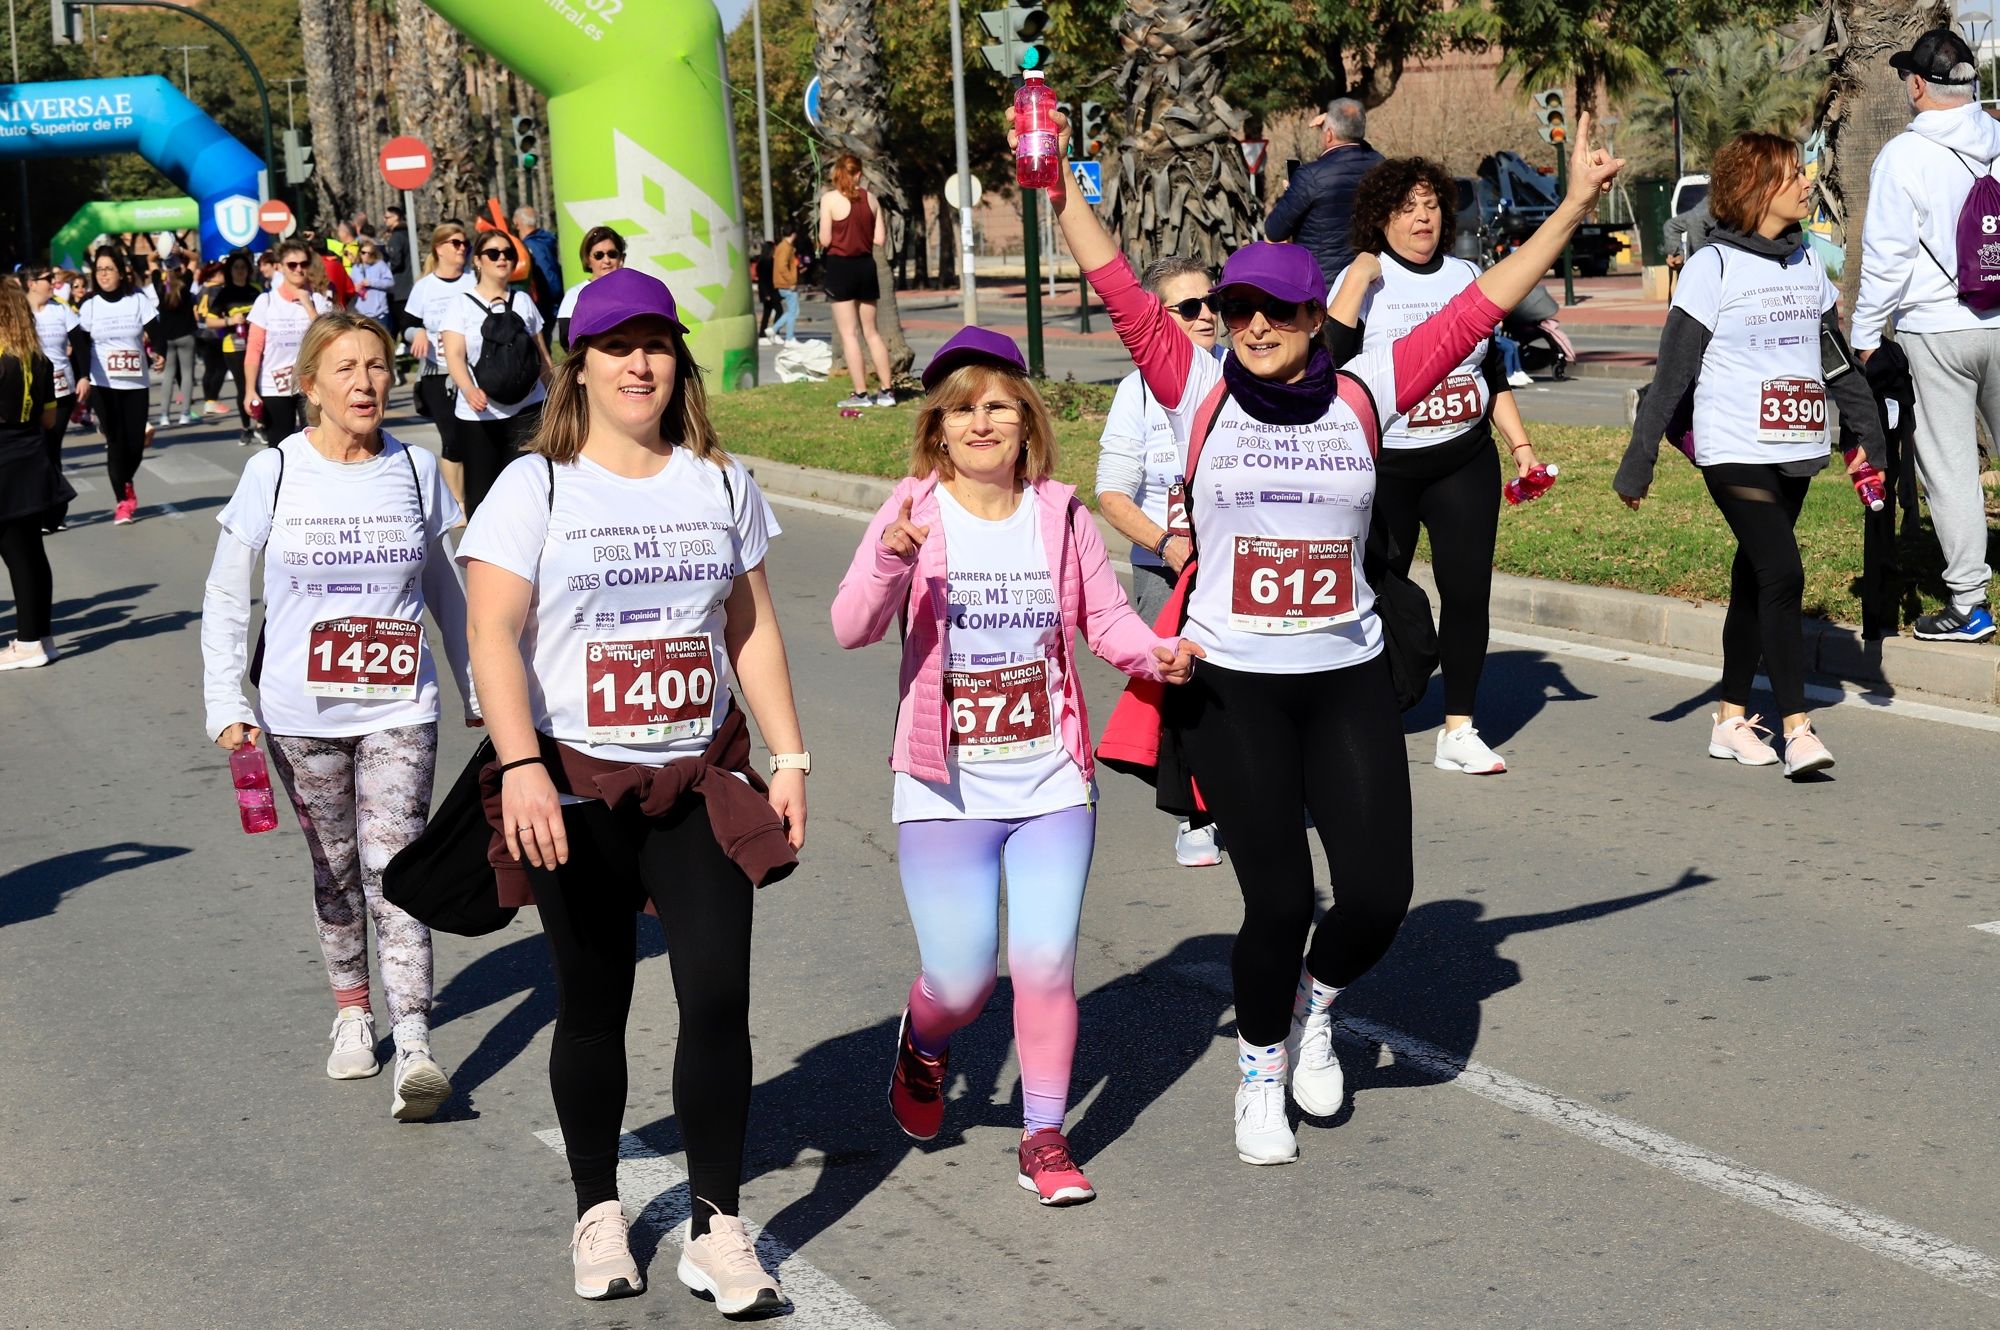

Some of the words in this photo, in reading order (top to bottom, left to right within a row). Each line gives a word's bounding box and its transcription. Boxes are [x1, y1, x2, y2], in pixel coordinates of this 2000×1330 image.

[31, 120, 90, 136] Superior
[92, 118, 111, 131] de
[114, 117, 133, 129] FP
[1782, 292, 1796, 305] MÍ
[108, 357, 140, 369] 1516
[1777, 384, 1800, 396] mujer
[1411, 390, 1477, 422] 2851
[1763, 398, 1824, 423] 3390
[1152, 423, 1167, 431] VIII
[1221, 420, 1238, 428] VIII
[1284, 425, 1296, 433] DE
[1299, 425, 1312, 434] LA
[1237, 436, 1271, 450] POR
[1274, 434, 1300, 452] MÍ
[1302, 440, 1314, 452] Y
[1318, 437, 1352, 452] POR
[1211, 455, 1239, 470] MIS
[1243, 453, 1373, 472] COMPAÑERAS
[286, 518, 302, 526] VIII
[349, 517, 360, 525] DE
[363, 516, 374, 524] LA
[376, 515, 402, 524] MUJER
[305, 533, 336, 545] POR
[340, 526, 361, 544] MÍ
[364, 531, 376, 543] Y
[378, 530, 407, 543] POR
[565, 529, 587, 540] VIII
[590, 527, 640, 538] CARRERA
[643, 525, 656, 534] DE
[660, 524, 672, 533] LA
[676, 522, 709, 532] MUJER
[284, 551, 308, 566] MIS
[312, 545, 423, 566] COMPAÑERAS
[594, 545, 631, 562] POR
[634, 536, 660, 558] MÍ
[664, 542, 676, 557] Y
[680, 540, 716, 556] POR
[1259, 546, 1298, 564] mujer
[1309, 543, 1348, 553] MURCIA
[568, 574, 600, 591] MIS
[605, 560, 735, 587] COMPAÑERAS
[949, 572, 992, 581] CARRERA
[995, 573, 1007, 581] DE
[1010, 573, 1021, 581] LA
[1024, 571, 1051, 580] MUJER
[949, 590, 982, 605] POR
[985, 583, 1008, 604] MÍ
[1012, 590, 1023, 604] Y
[1026, 589, 1055, 604] POR
[1250, 567, 1337, 605] 612
[333, 622, 368, 638] mujer
[376, 621, 417, 632] MURCIA
[605, 643, 633, 651] carrera
[665, 641, 706, 653] MURCIA
[314, 640, 416, 675] 1426
[614, 648, 655, 668] mujer
[1000, 666, 1041, 681] MURCIA
[1014, 678, 1031, 686] MARZO
[592, 668, 712, 712] 1400
[953, 678, 991, 693] mujer
[648, 714, 668, 722] LAIA
[949, 692, 1035, 733] 674
[980, 734, 1017, 743] EUGENIA
